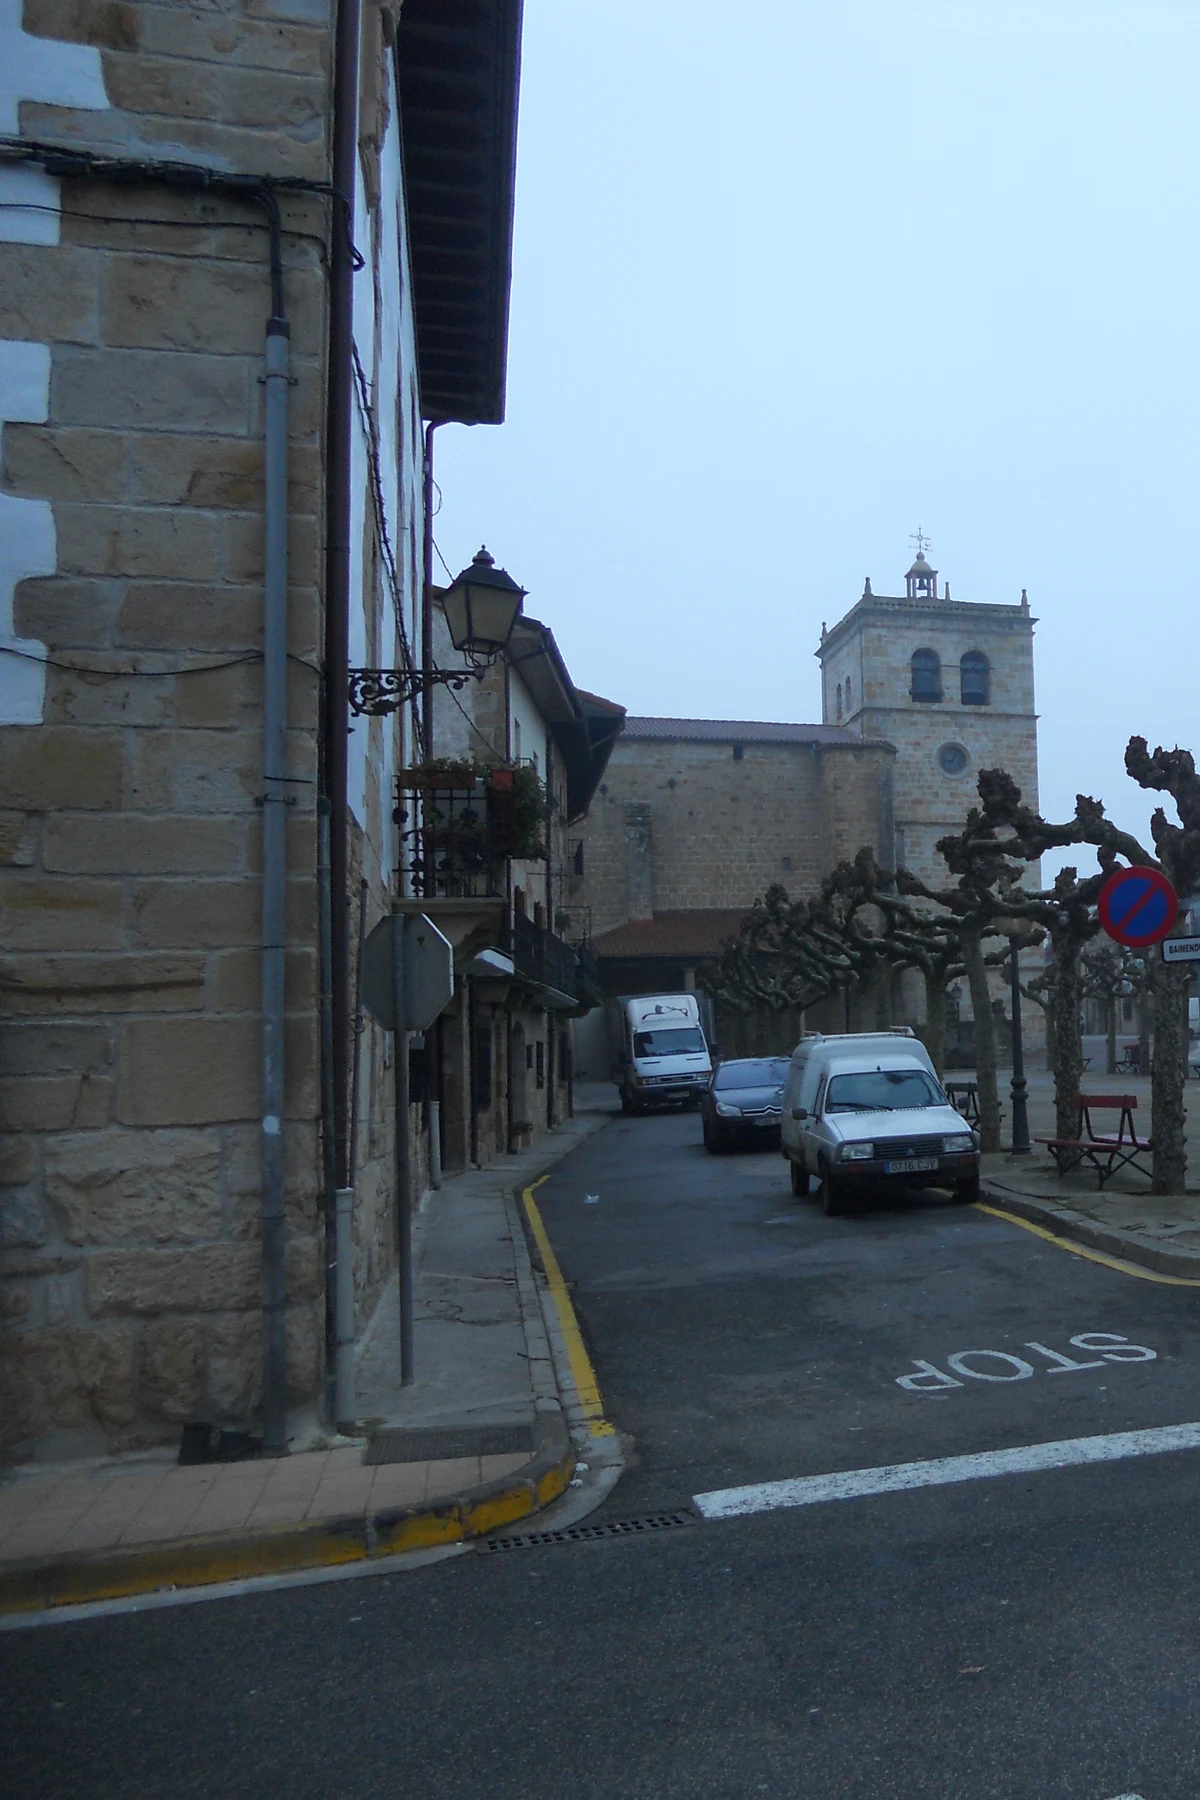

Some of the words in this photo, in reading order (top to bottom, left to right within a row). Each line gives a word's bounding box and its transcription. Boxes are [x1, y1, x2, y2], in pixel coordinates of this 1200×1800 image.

[891, 1161, 914, 1171] 0716
[917, 1159, 935, 1170] CJV
[895, 1332, 1158, 1391] STOP
